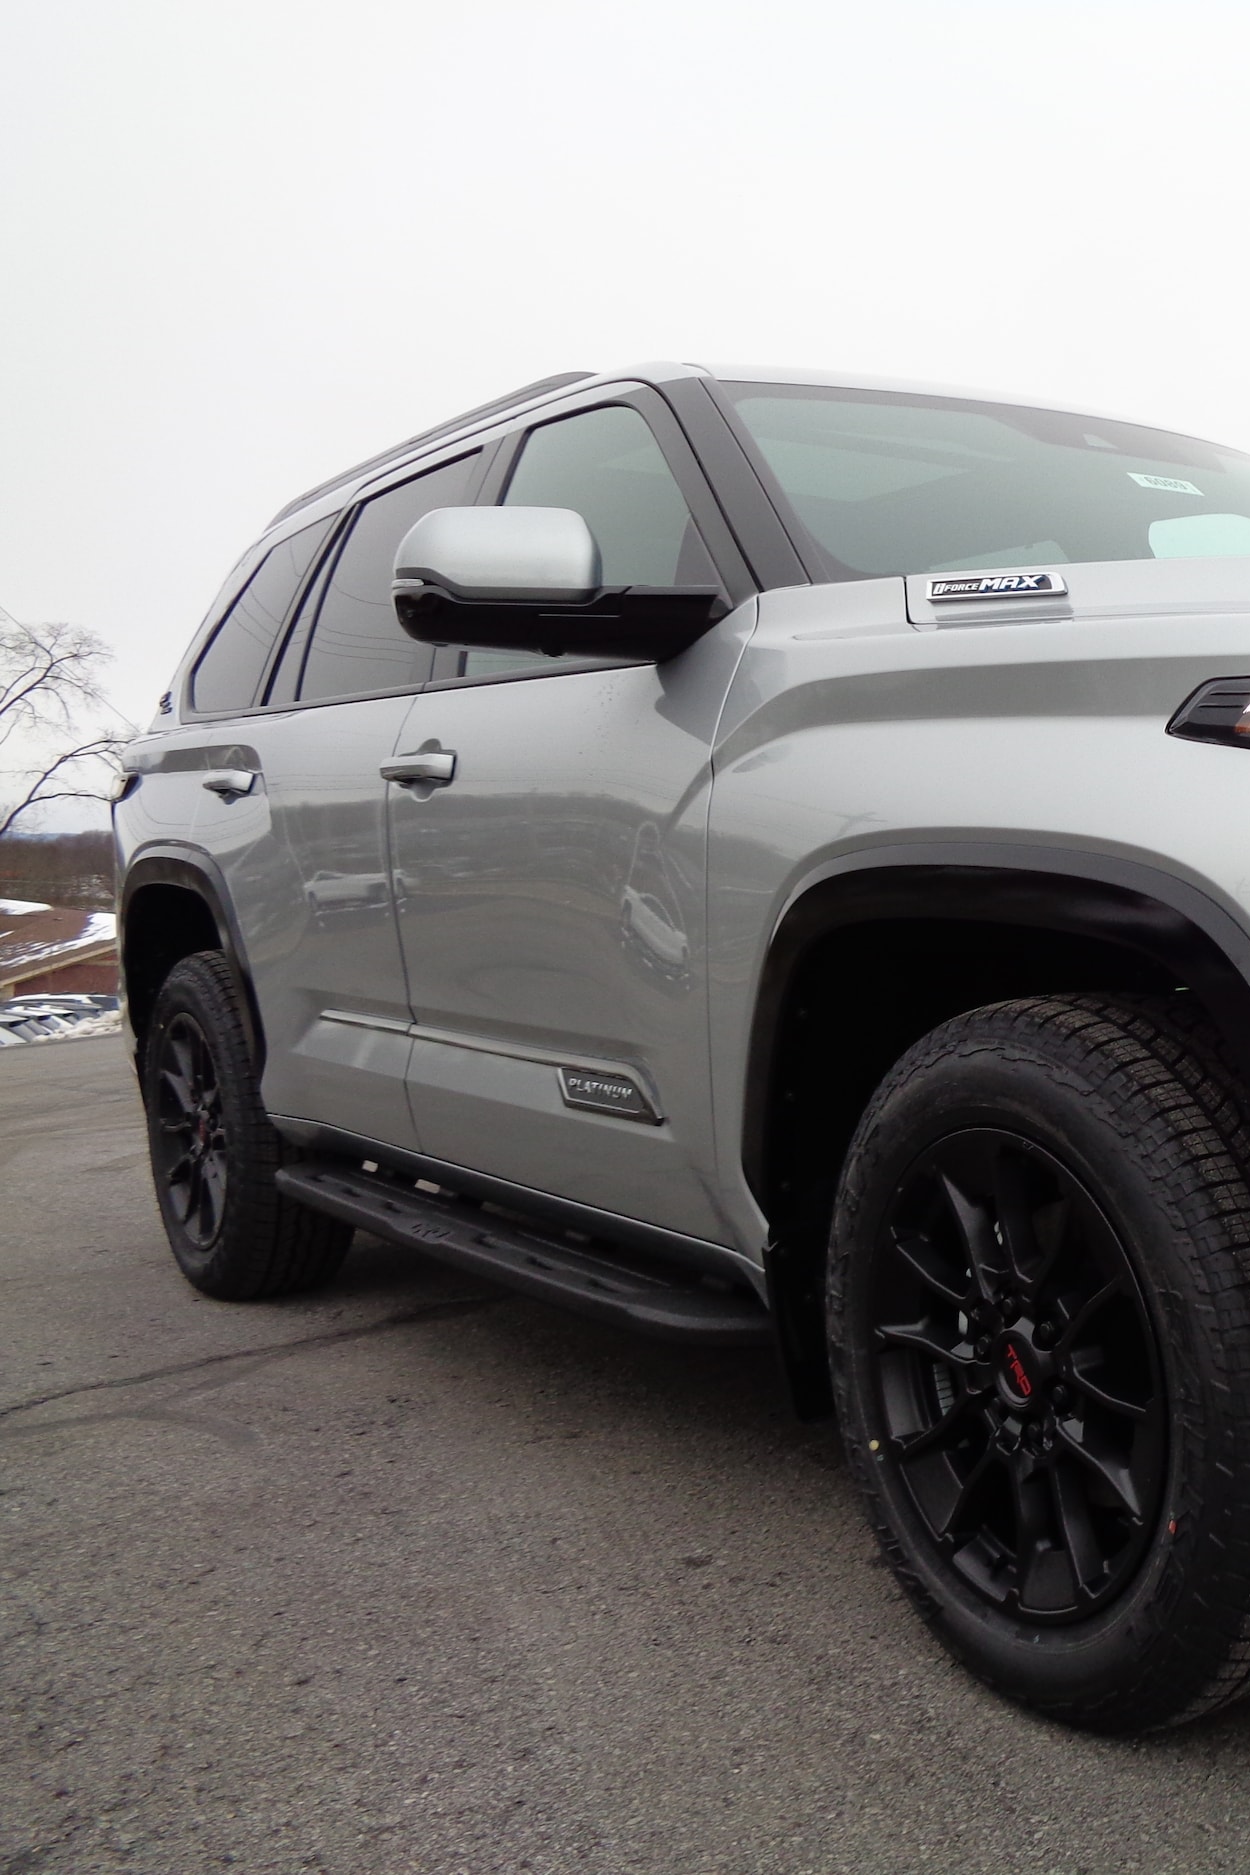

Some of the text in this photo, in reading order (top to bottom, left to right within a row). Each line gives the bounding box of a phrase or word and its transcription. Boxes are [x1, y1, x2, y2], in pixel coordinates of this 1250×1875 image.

[980, 575, 1042, 591] MAX
[569, 1078, 632, 1098] PLATINUM
[1007, 1343, 1032, 1396] TRD
